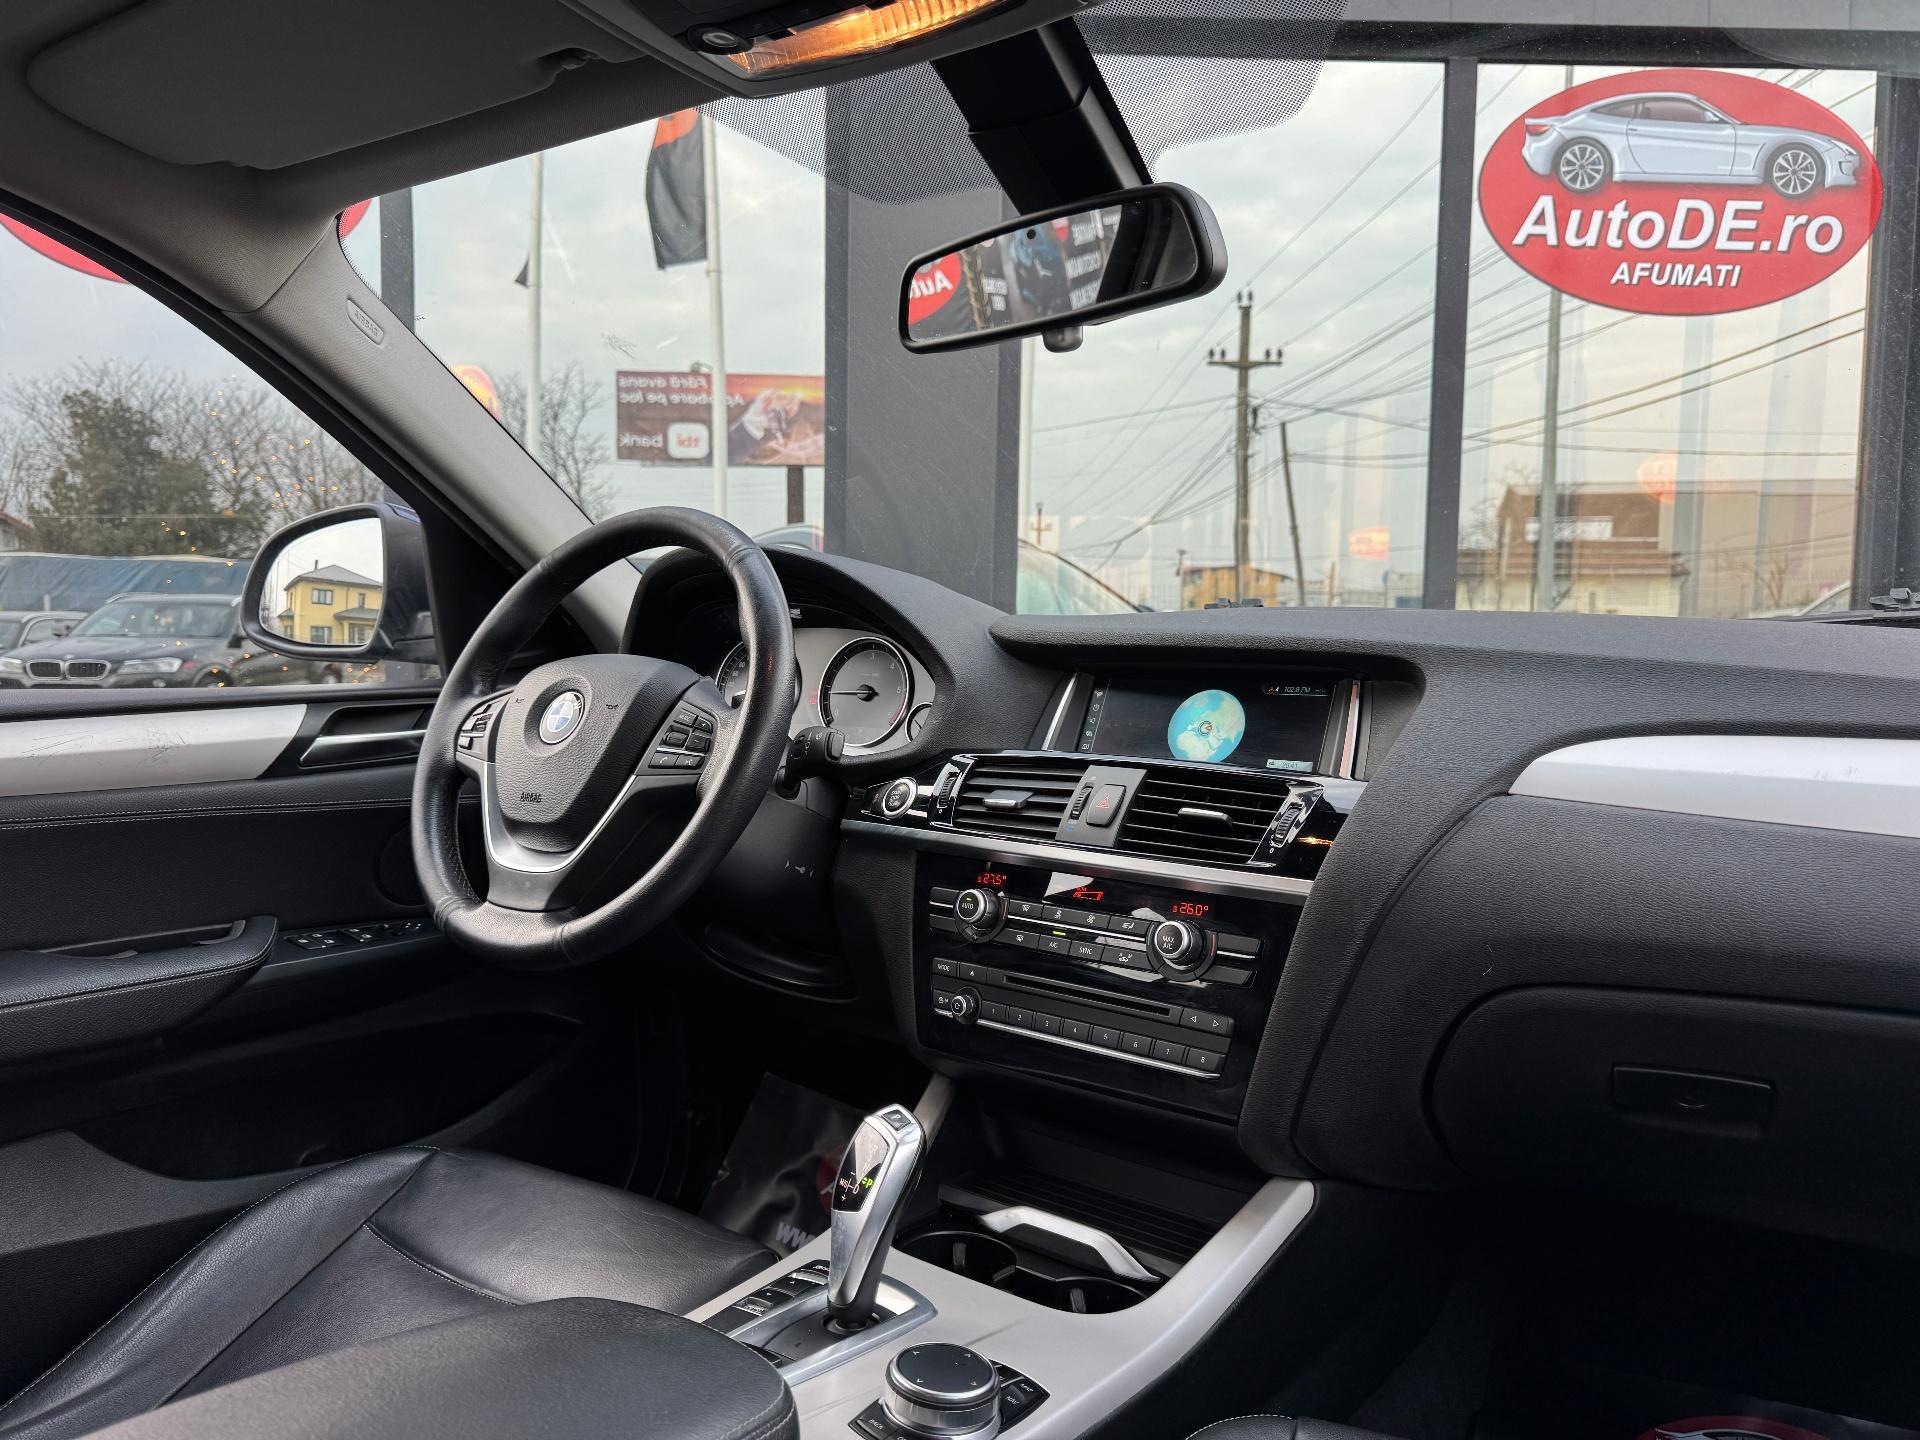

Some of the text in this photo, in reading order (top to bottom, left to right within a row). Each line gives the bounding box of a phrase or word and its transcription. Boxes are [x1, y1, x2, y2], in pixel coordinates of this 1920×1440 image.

[1512, 194, 1844, 253] AutoDE.ro
[1610, 262, 1742, 288] AFUMATI
[1079, 946, 1093, 955] SYNC
